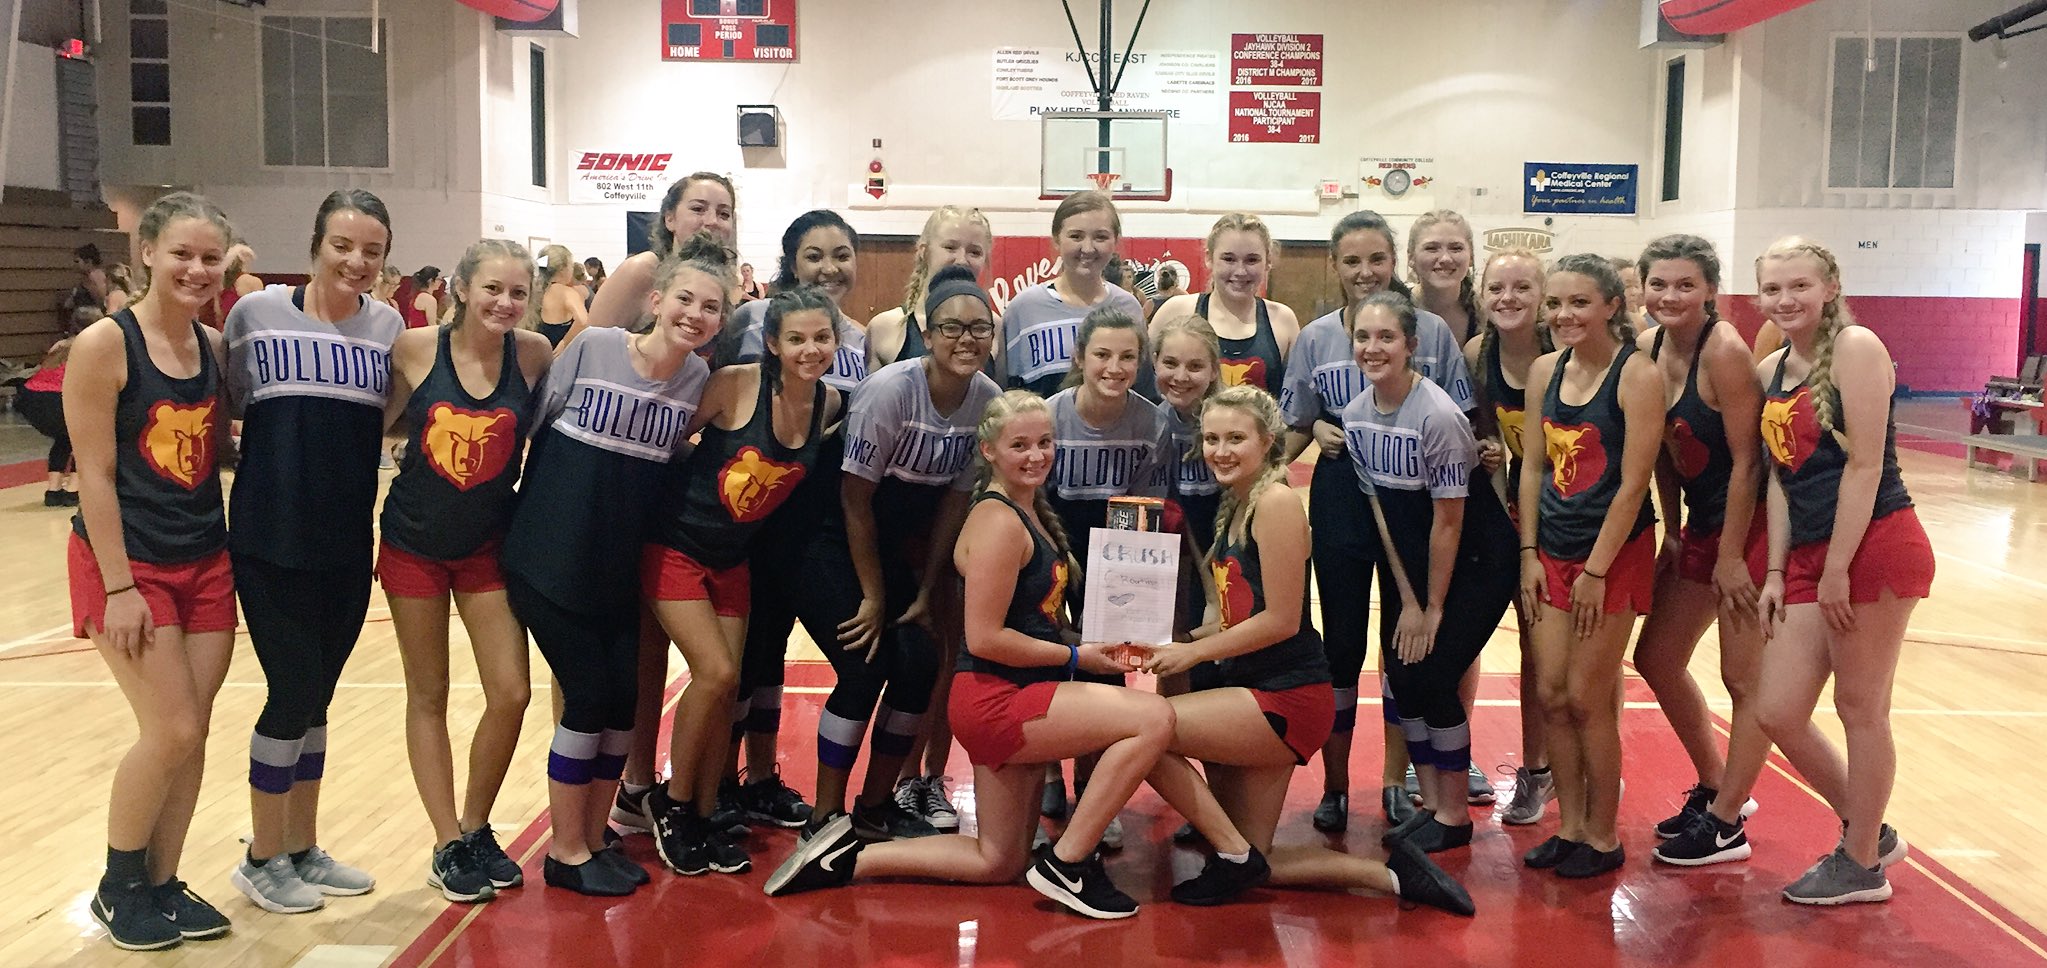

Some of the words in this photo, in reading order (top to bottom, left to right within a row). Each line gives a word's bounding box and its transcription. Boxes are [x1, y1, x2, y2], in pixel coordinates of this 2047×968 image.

[715, 31, 742, 39] PERIOD
[1256, 34, 1299, 42] VOLLEYBALL
[1244, 43, 1275, 51] JAYHAWK
[1276, 43, 1305, 51] DIVISION
[1306, 43, 1311, 51] 2
[670, 47, 700, 57] HOME
[753, 48, 793, 58] VISITOR
[1233, 51, 1280, 59] CONFERENCE
[1280, 52, 1320, 60] CHAMPIONS
[1270, 60, 1284, 68] 38-4
[1238, 68, 1268, 76] DISTRICT
[1301, 77, 1317, 85] 2017
[1253, 92, 1297, 100] VOLLEYBALL
[1234, 108, 1268, 116] NATIONAL
[1269, 109, 1314, 117] TOURNAMENT
[1253, 117, 1295, 125] PARTICIPANT
[1267, 125, 1281, 133] 38-4
[577, 153, 672, 171] SONIC
[580, 172, 625, 181] America's
[1551, 171, 1592, 181] Coffeyville
[1594, 172, 1629, 181] Regional
[604, 192, 646, 200] Coffeyville
[1552, 196, 1586, 206] partner
[1600, 195, 1626, 205] health
[1486, 230, 1552, 250] TACHIKARA
[1858, 240, 1878, 249] MEN
[578, 387, 695, 450] BULLDOG
[1103, 542, 1173, 567] CRUSH
